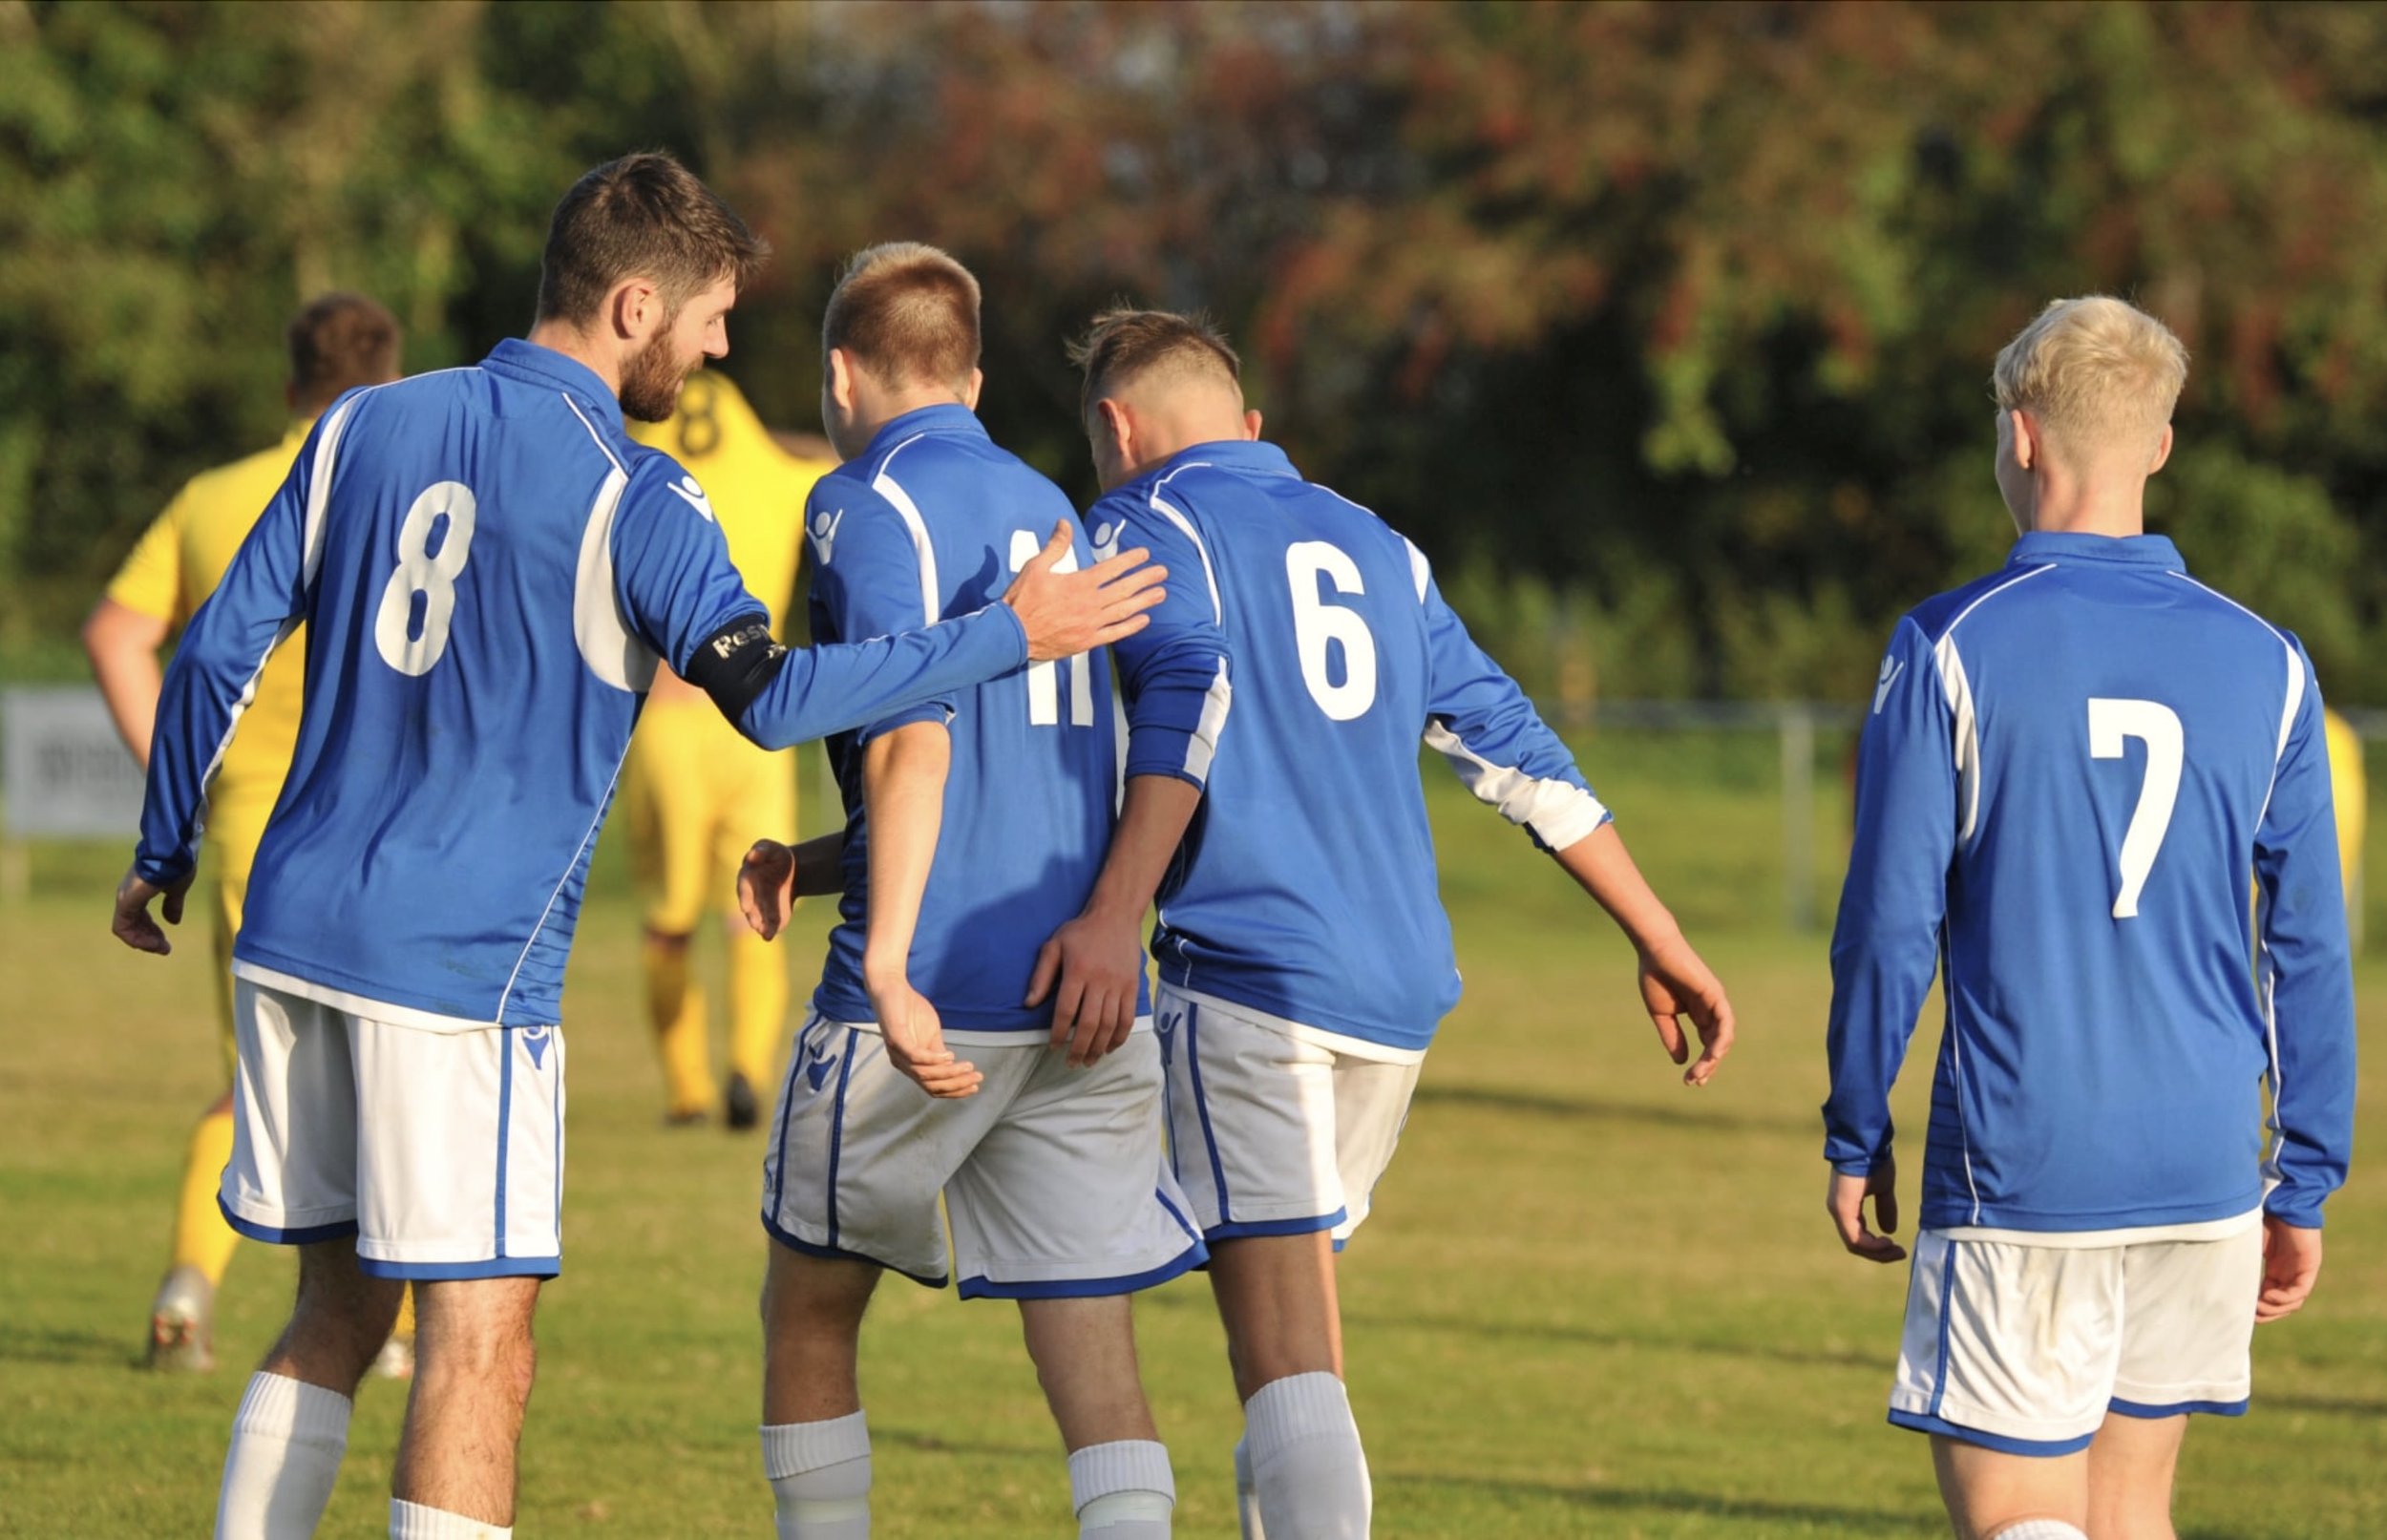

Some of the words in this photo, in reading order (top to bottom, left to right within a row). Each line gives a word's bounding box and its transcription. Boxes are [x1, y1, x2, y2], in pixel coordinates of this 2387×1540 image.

[680, 371, 720, 457] 8
[374, 481, 476, 676] 8
[1286, 540, 1377, 721] 6
[2088, 698, 2185, 918] 7
